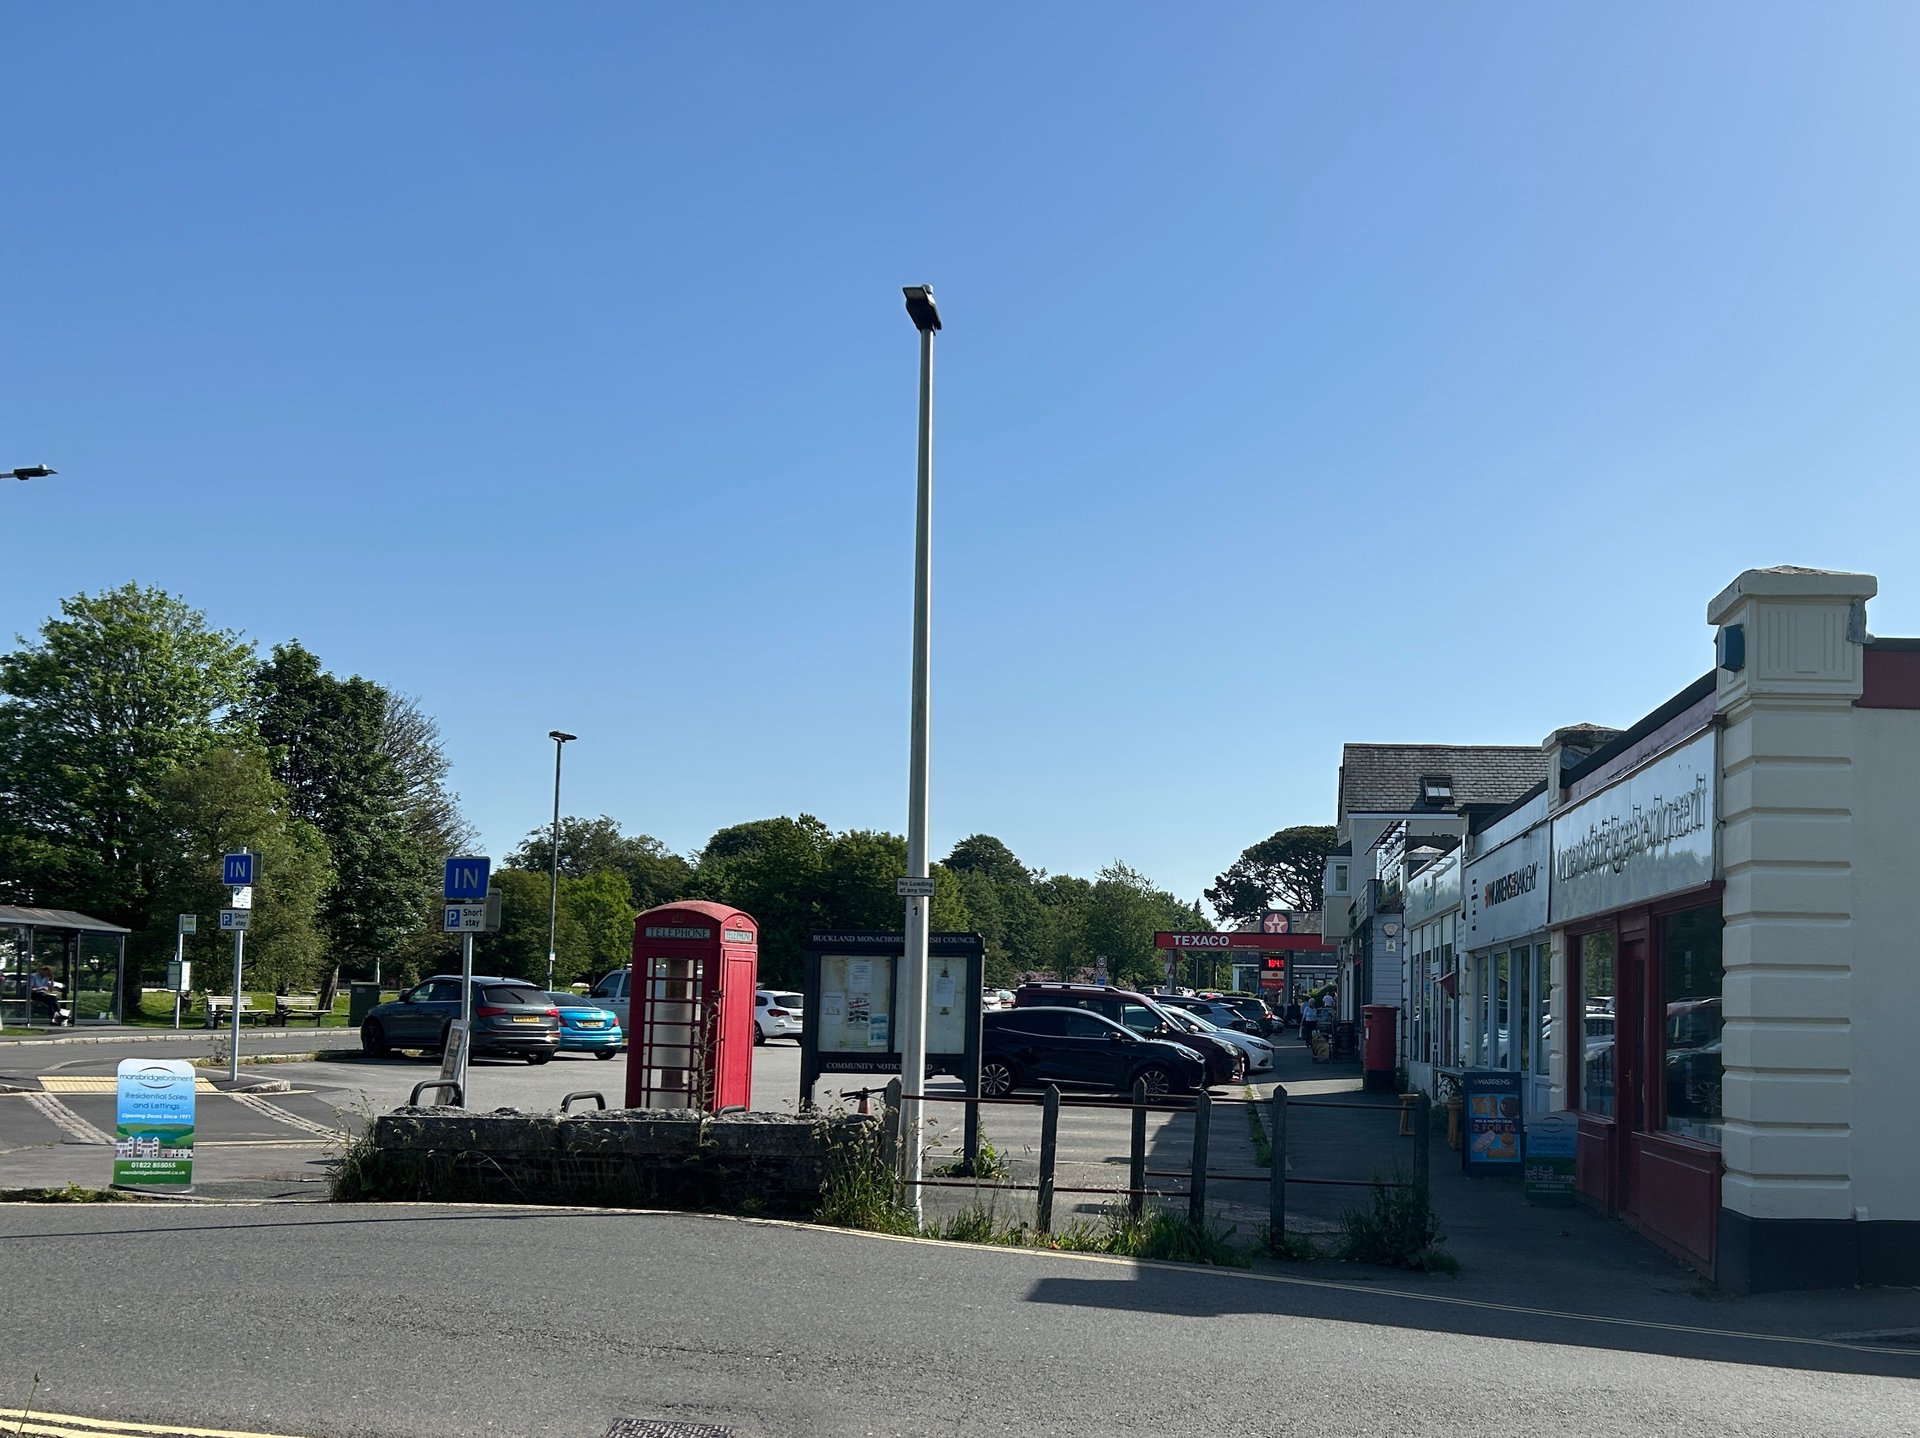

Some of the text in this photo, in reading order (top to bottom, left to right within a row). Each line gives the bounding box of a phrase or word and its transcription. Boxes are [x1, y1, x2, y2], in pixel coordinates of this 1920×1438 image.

[230, 861, 246, 878] IN
[454, 867, 479, 889] IN
[463, 908, 483, 917] Short
[912, 905, 919, 916] 1
[449, 911, 457, 926] P
[465, 918, 480, 927] stay
[650, 928, 708, 938] TELEPHONE
[812, 935, 856, 943] BUCKLAND
[857, 936, 905, 944] MONACHOR
[943, 936, 977, 944] COUNCIL
[1173, 935, 1230, 947] TEXACO
[826, 1062, 874, 1070] COMMUNITY
[125, 1092, 188, 1101] Residential Sales
[151, 1102, 180, 1111] Lettings
[1482, 1124, 1501, 1132] FOR
